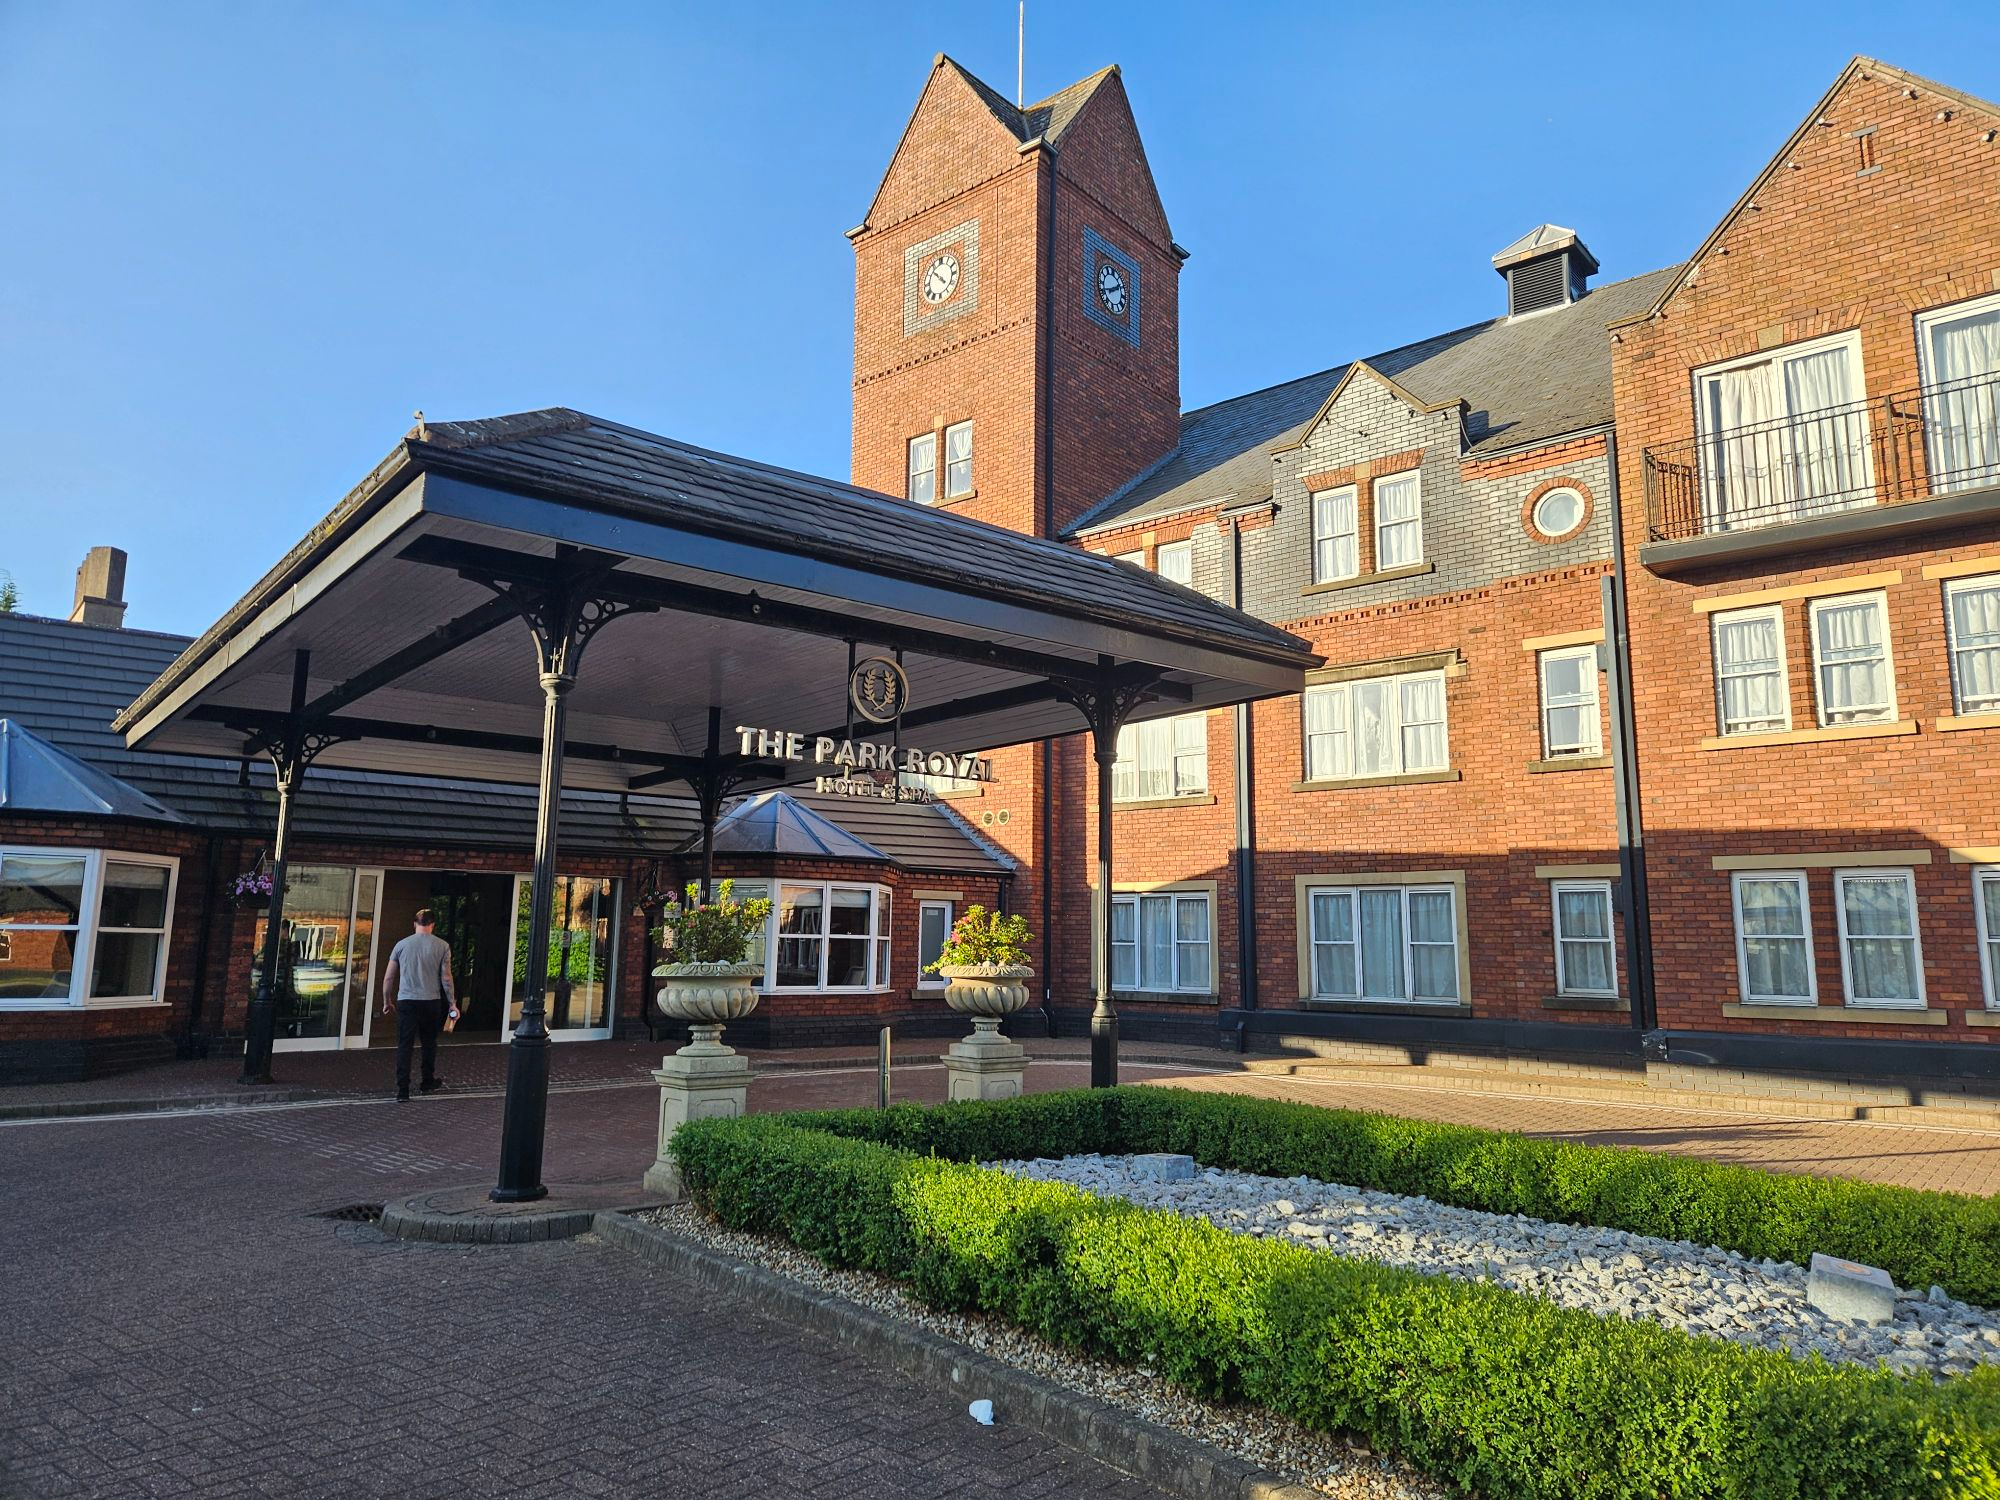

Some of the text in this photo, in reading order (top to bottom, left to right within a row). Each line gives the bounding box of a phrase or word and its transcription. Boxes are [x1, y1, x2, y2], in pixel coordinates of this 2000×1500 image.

[736, 726, 999, 783] THE PARK ROYAL
[816, 776, 932, 803] HOTEL & SPA
